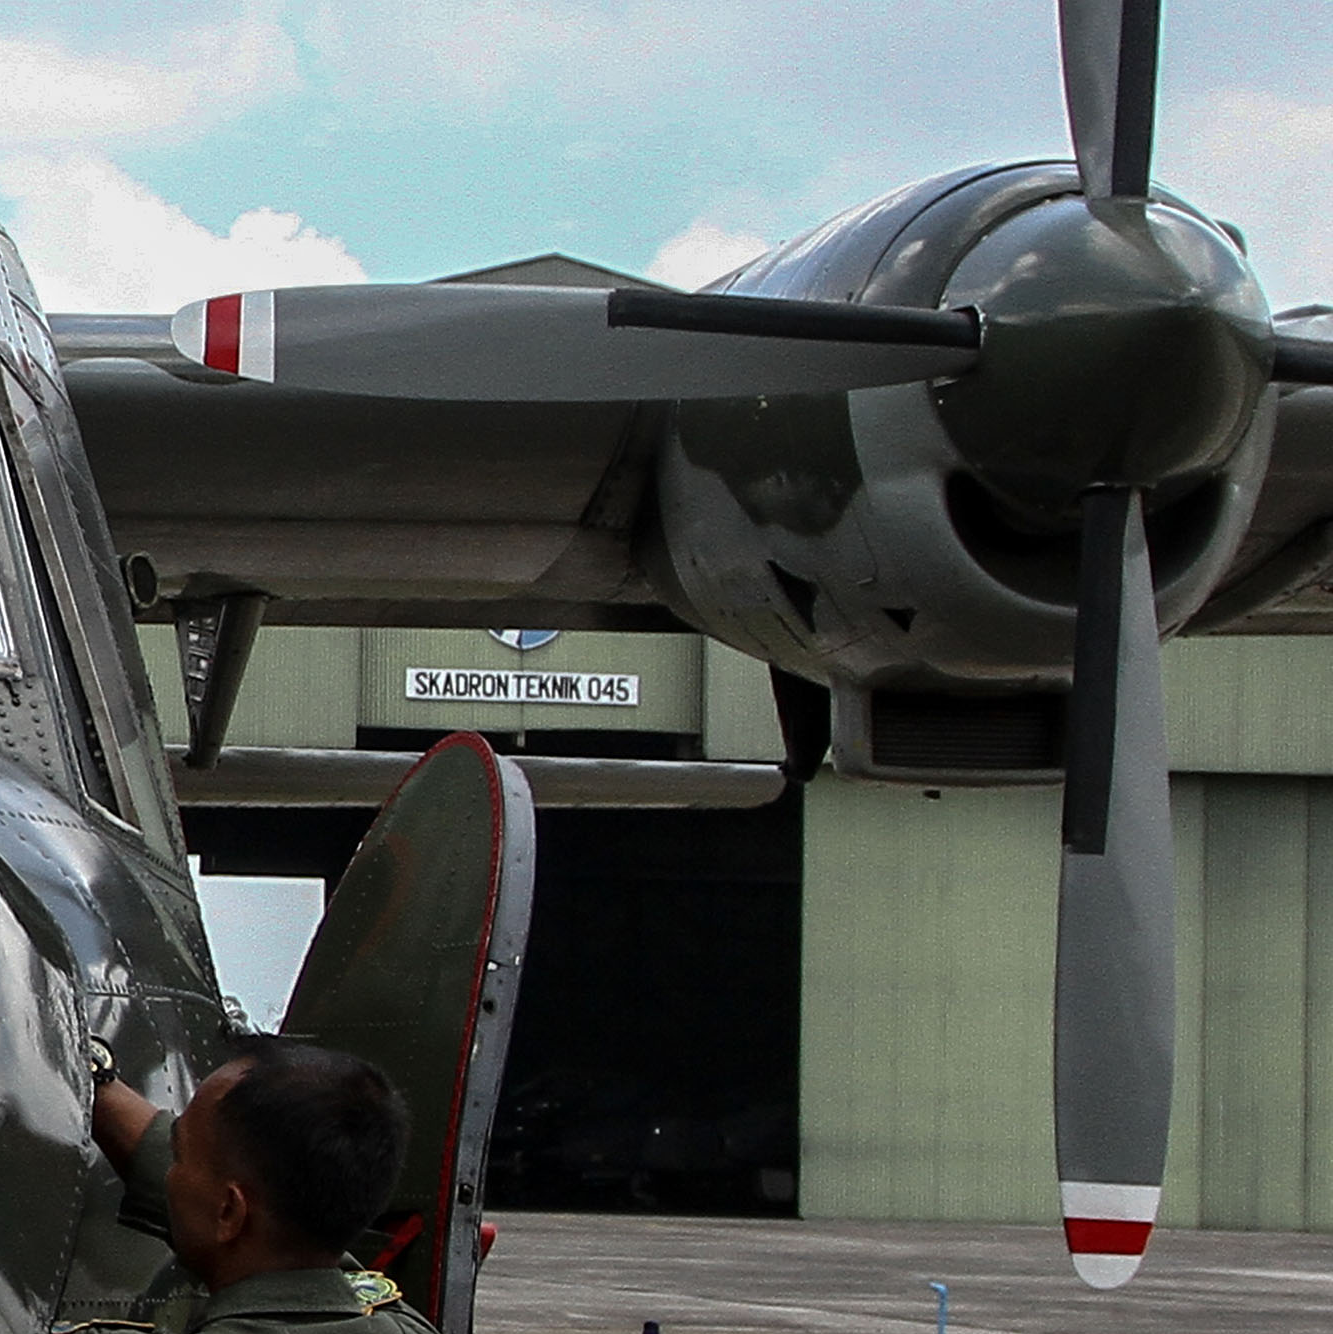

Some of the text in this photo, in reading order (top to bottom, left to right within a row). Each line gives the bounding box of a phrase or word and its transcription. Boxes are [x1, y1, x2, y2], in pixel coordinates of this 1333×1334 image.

[415, 672, 630, 702] SKADRON TEKNIK 045
